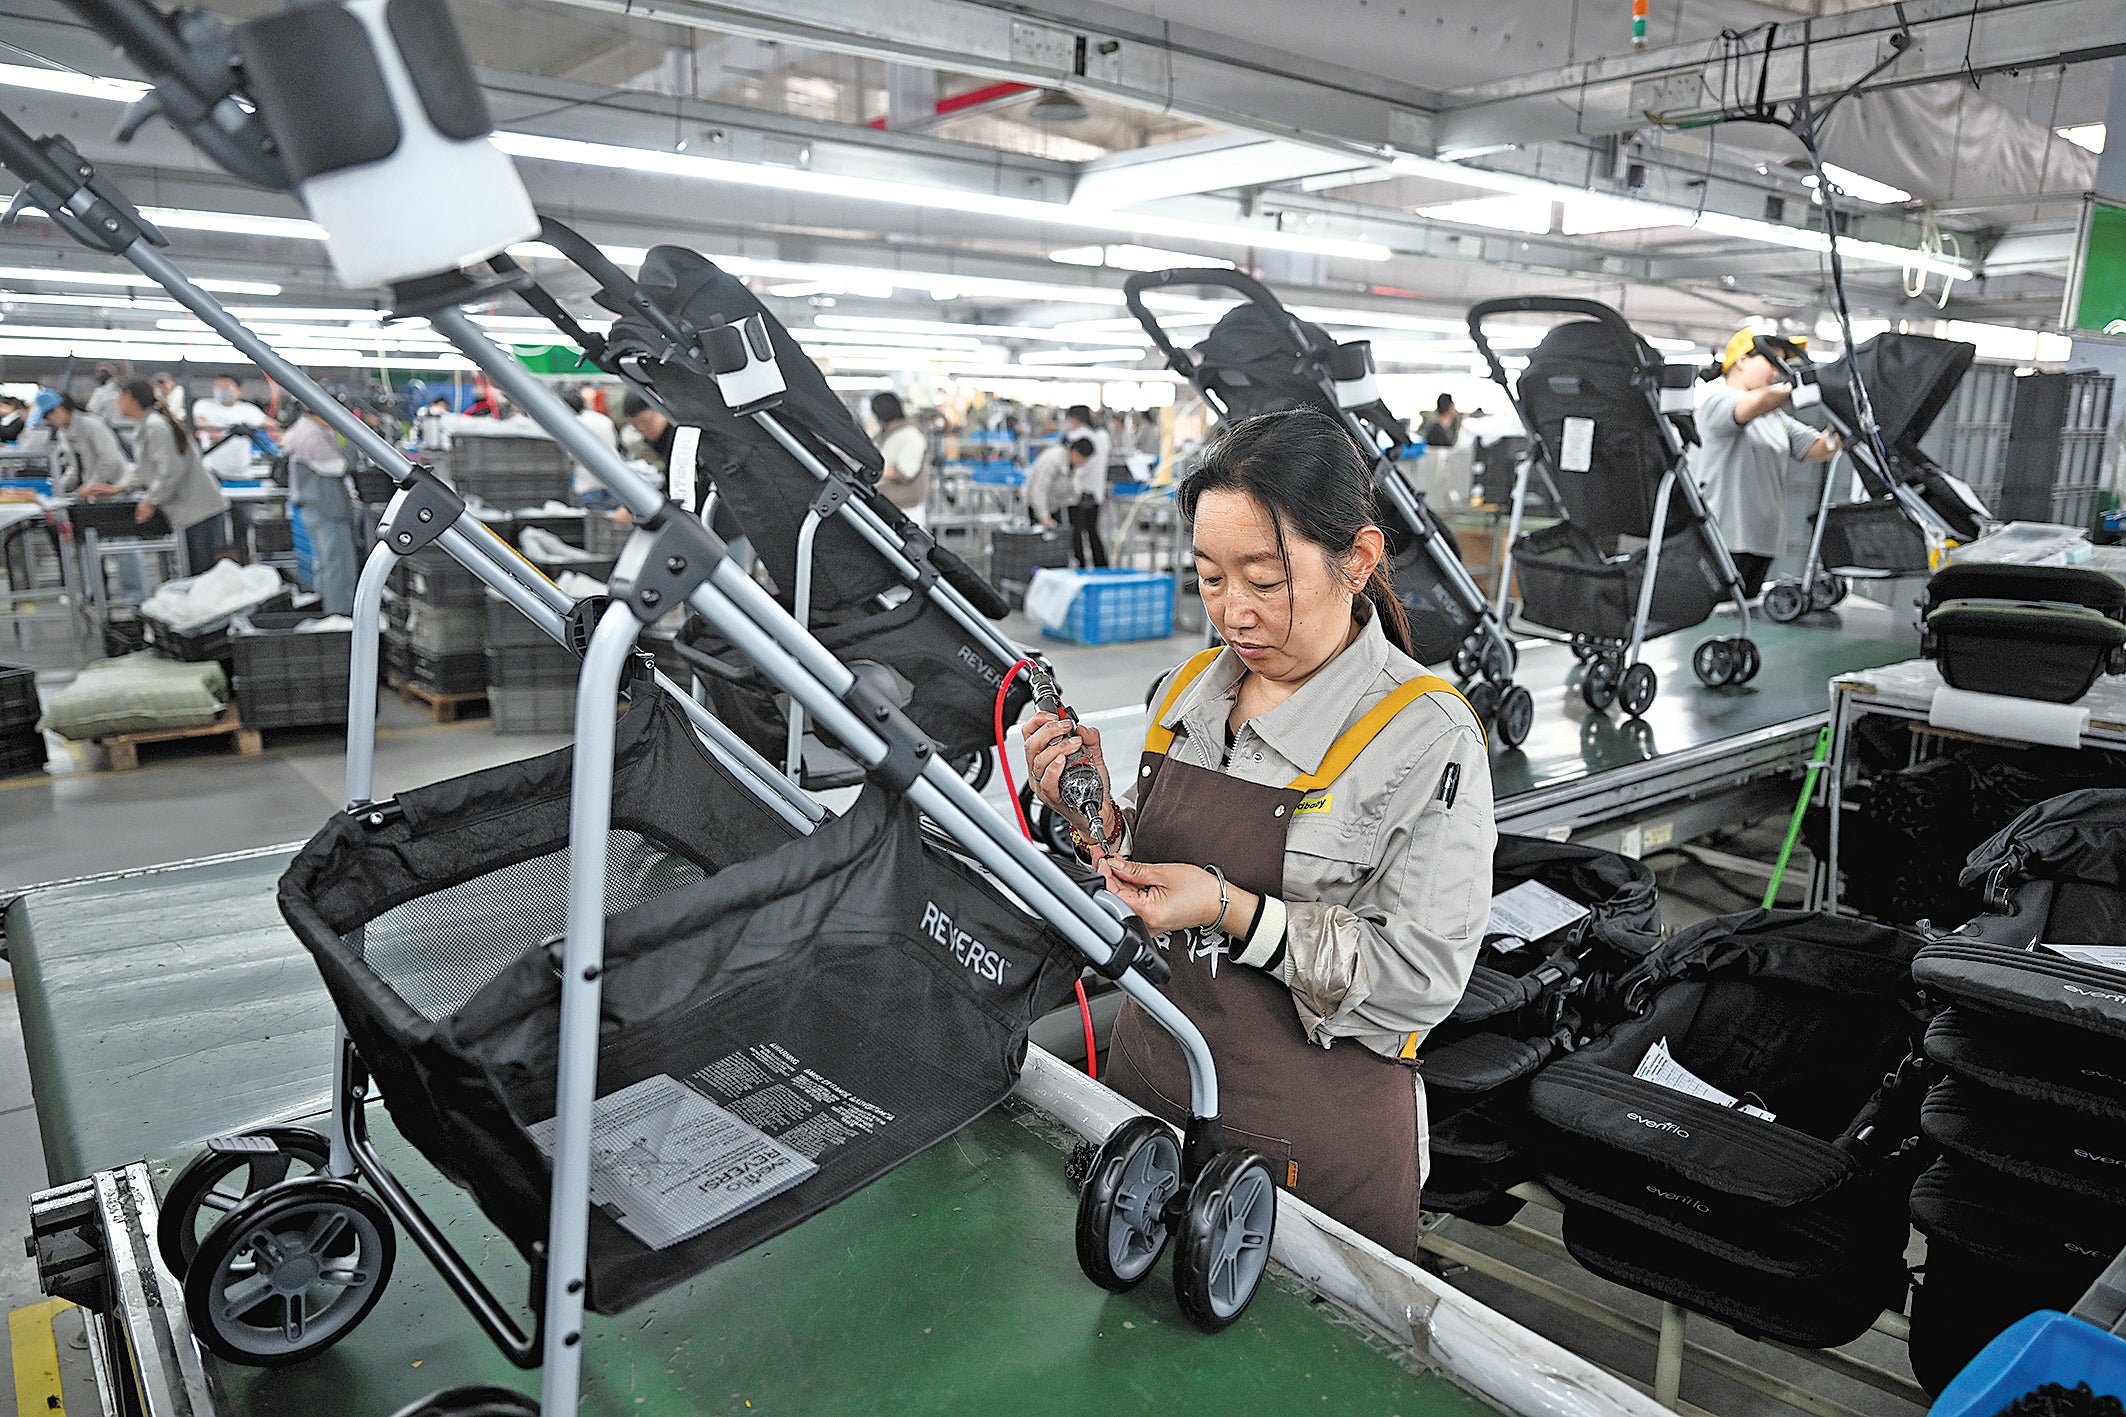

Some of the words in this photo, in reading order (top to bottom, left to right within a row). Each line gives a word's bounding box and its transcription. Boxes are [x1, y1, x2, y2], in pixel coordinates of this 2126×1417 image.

[957, 645, 1018, 698] REVERI
[920, 900, 1006, 986] REVERSI
[1626, 1112, 1690, 1139] evenflo
[699, 1147, 783, 1194] REVERSI
